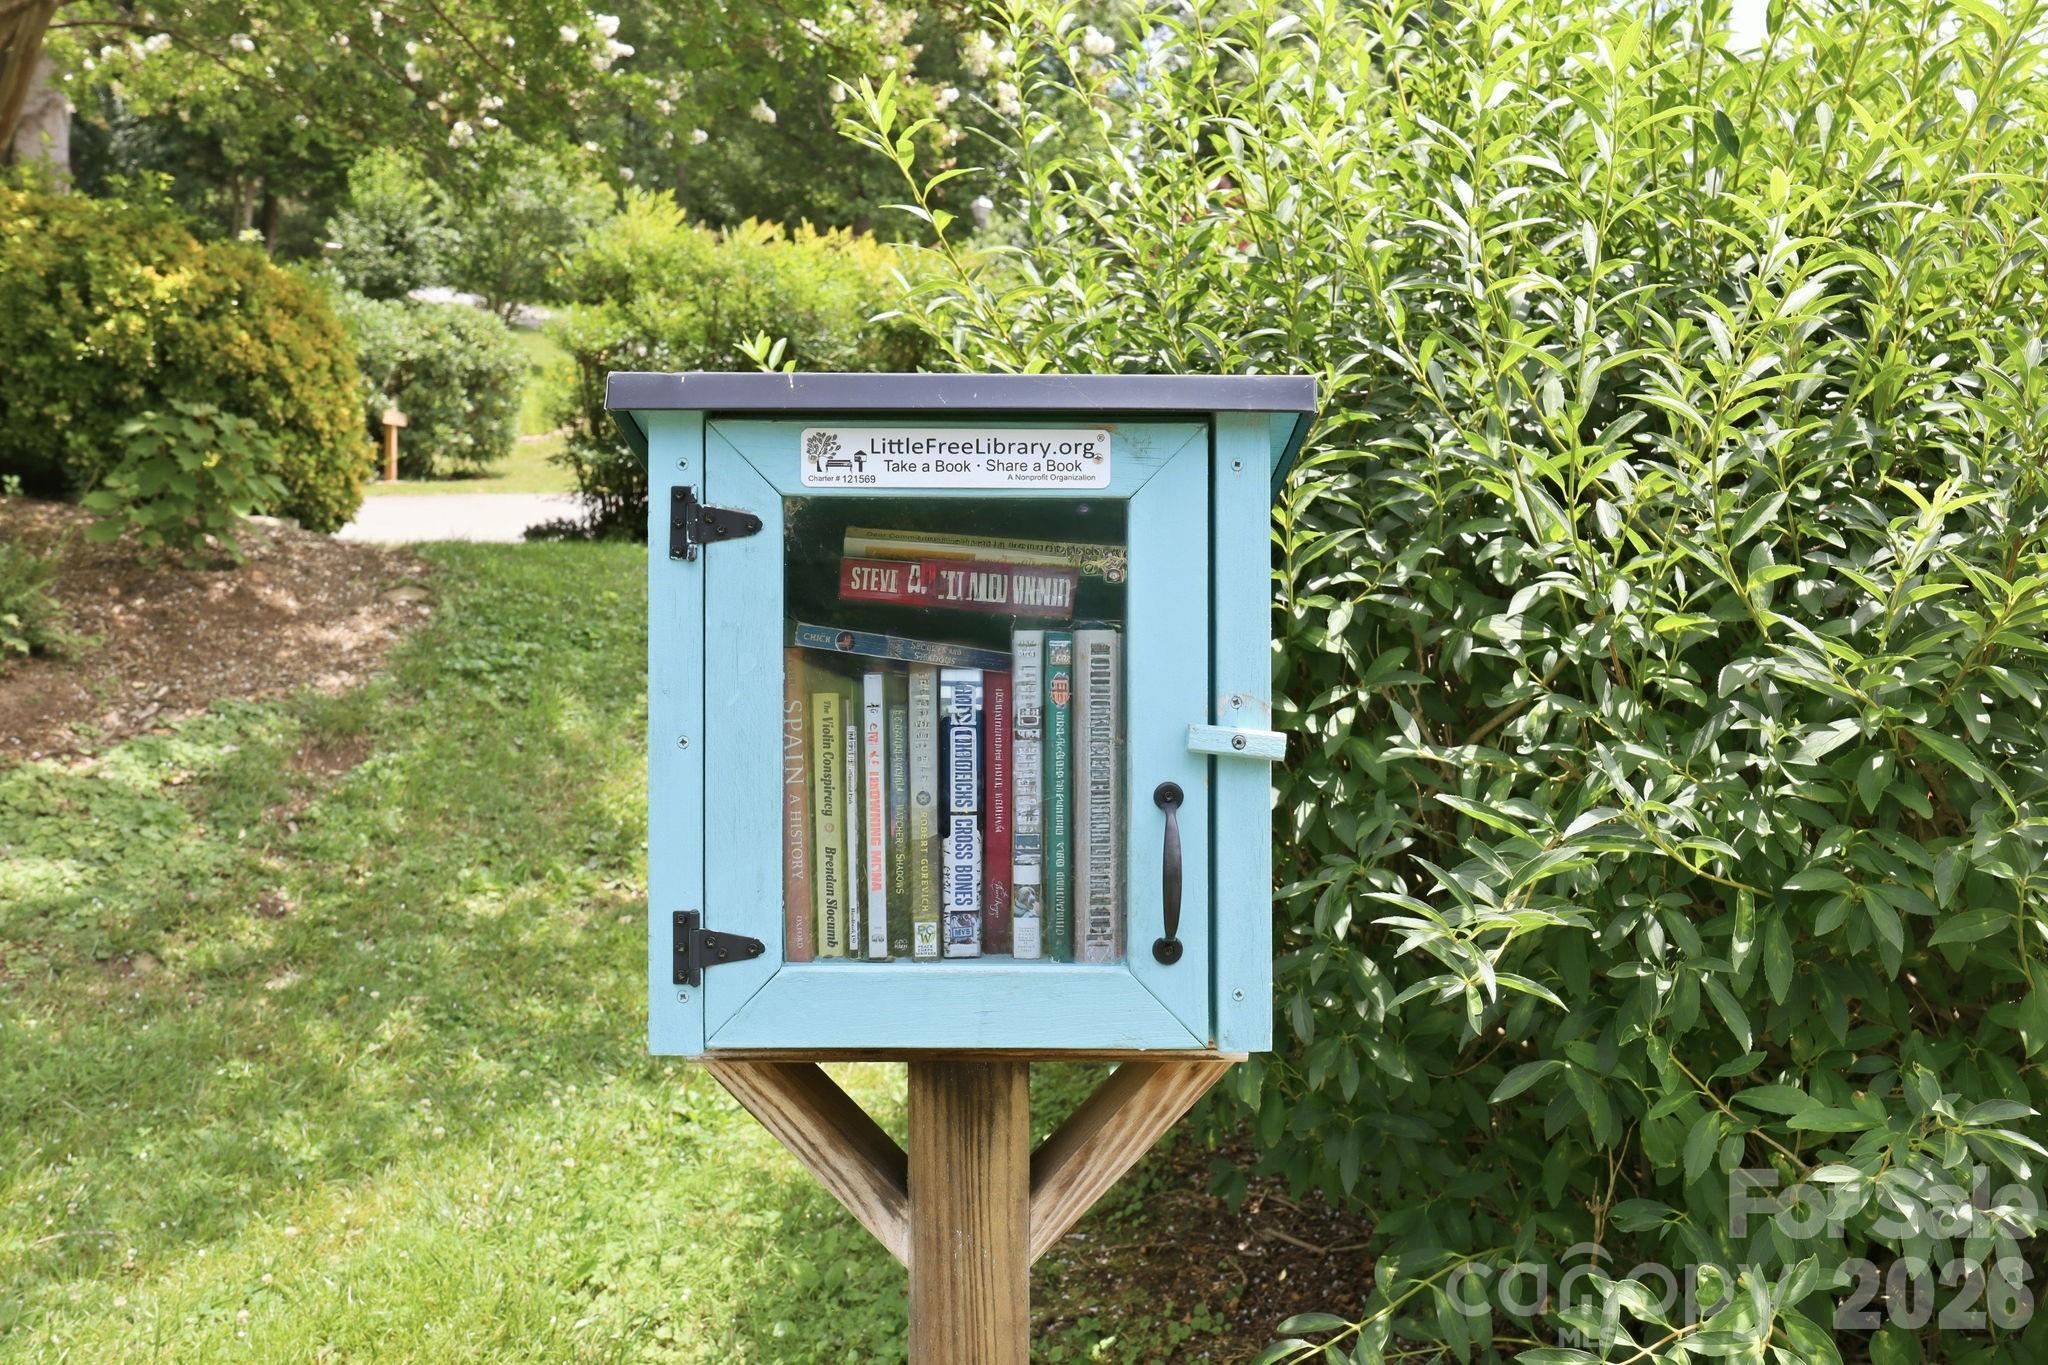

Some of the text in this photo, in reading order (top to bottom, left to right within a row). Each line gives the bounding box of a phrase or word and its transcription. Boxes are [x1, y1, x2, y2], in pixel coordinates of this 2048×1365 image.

[808, 474, 834, 482] Charter
[842, 474, 876, 484] 121569
[884, 459, 1082, 473] Take a Book Share a Book
[1015, 473, 1048, 481] Nonprofit
[1050, 473, 1096, 482] Organization
[820, 700, 836, 817] The Violin Conspiracy
[783, 700, 805, 880] SPAIN A HISTORY
[954, 818, 973, 860] CROSS
[919, 811, 929, 912] ROBERT GUREVICH
[824, 846, 839, 949] Brendan Slocumb
[954, 864, 973, 906] BONES
